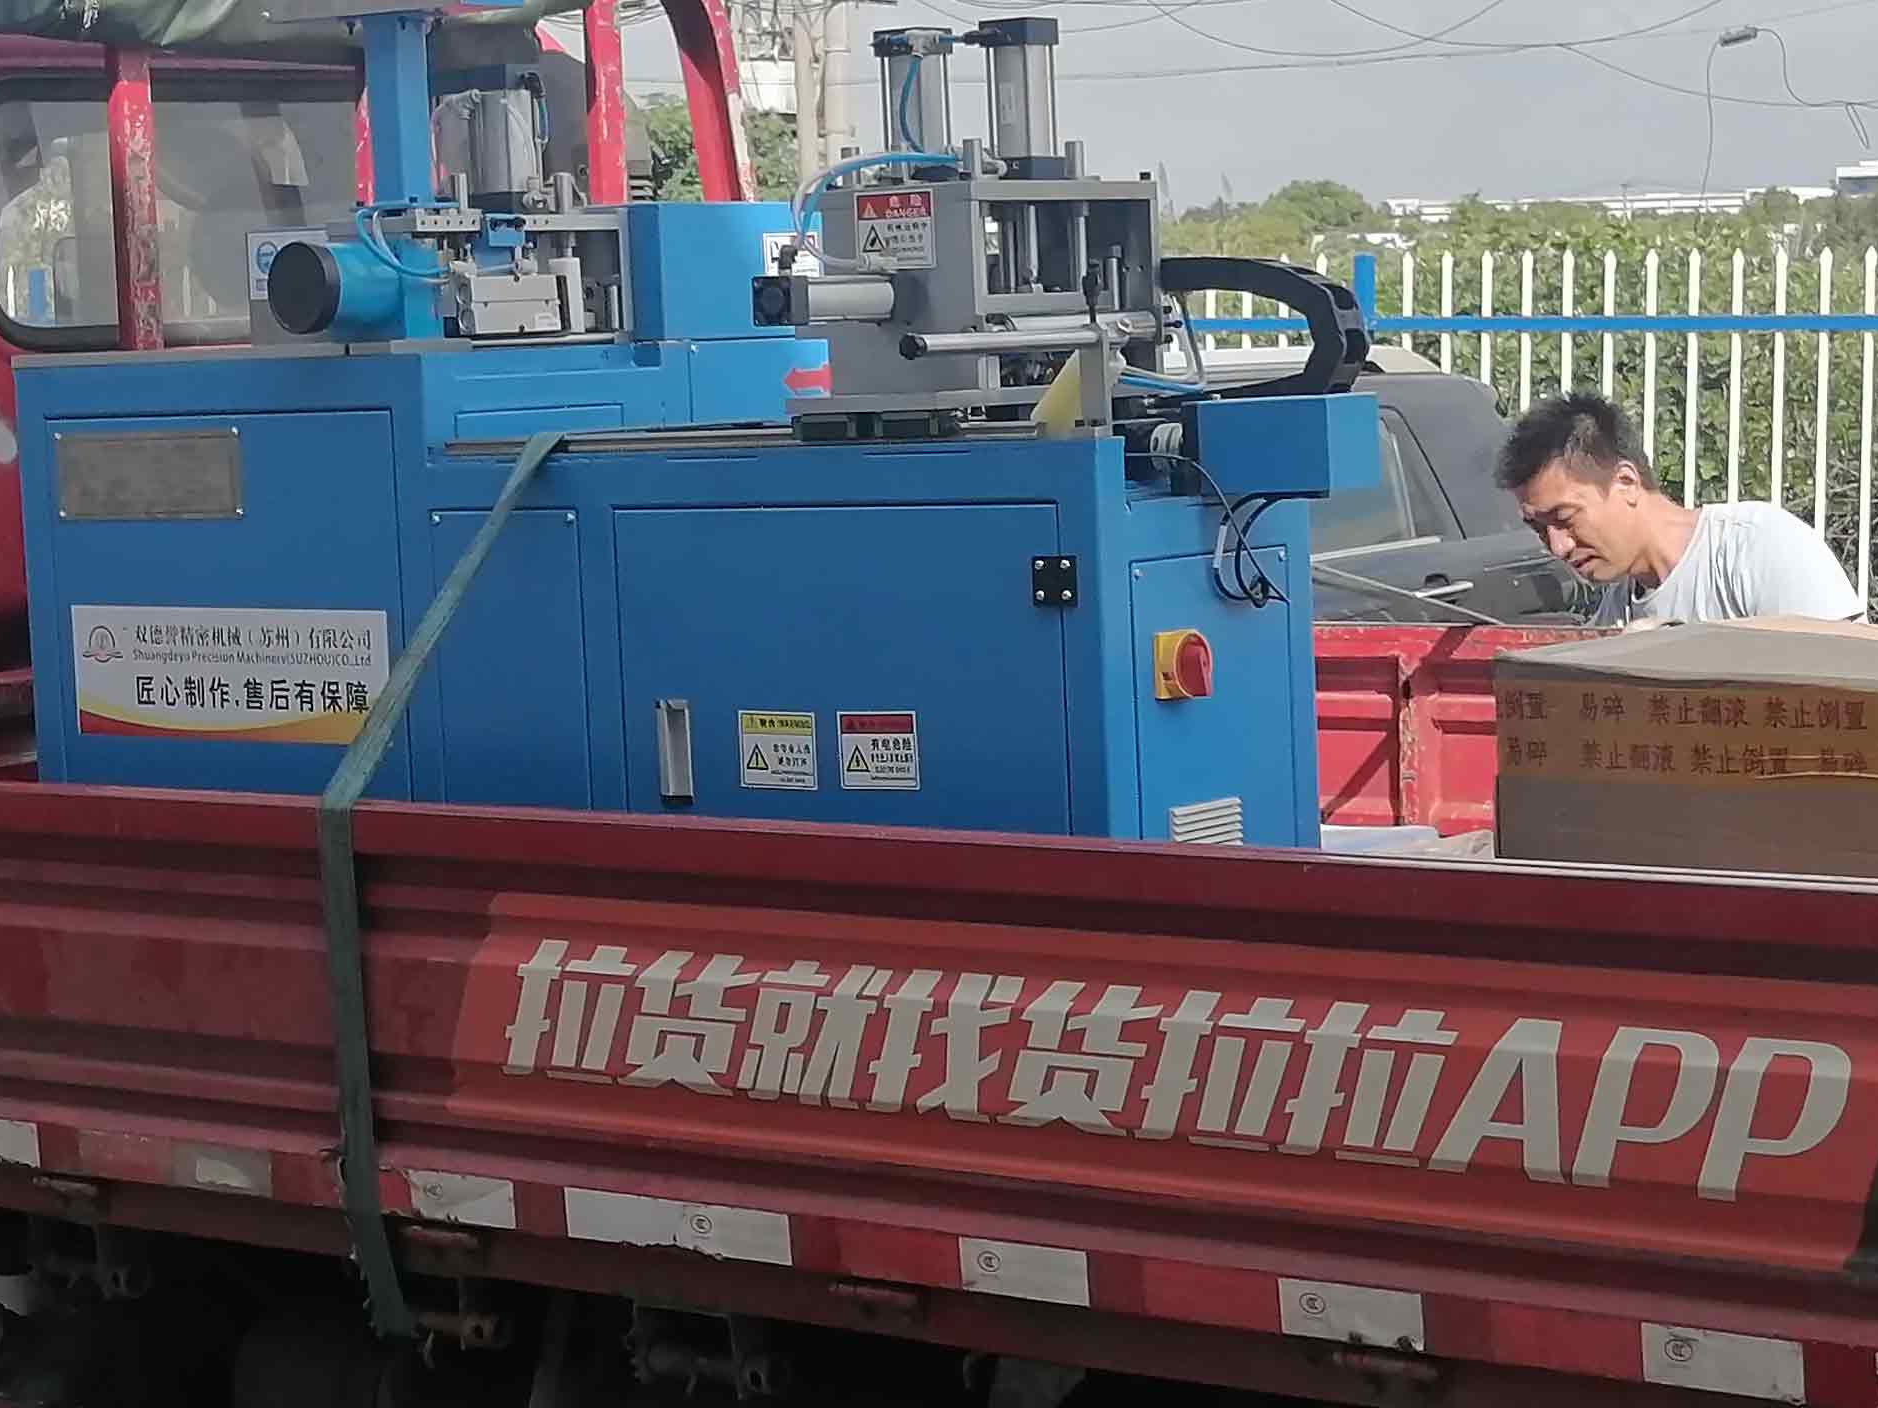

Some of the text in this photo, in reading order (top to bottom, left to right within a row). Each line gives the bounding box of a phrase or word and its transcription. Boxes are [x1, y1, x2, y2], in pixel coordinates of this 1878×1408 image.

[1579, 693, 1625, 723] 易碎
[1764, 696, 1868, 730] 禁止倒置
[1690, 743, 1790, 776] 禁止倒置
[502, 938, 1853, 1202] 拉货就找货拉拉APP
